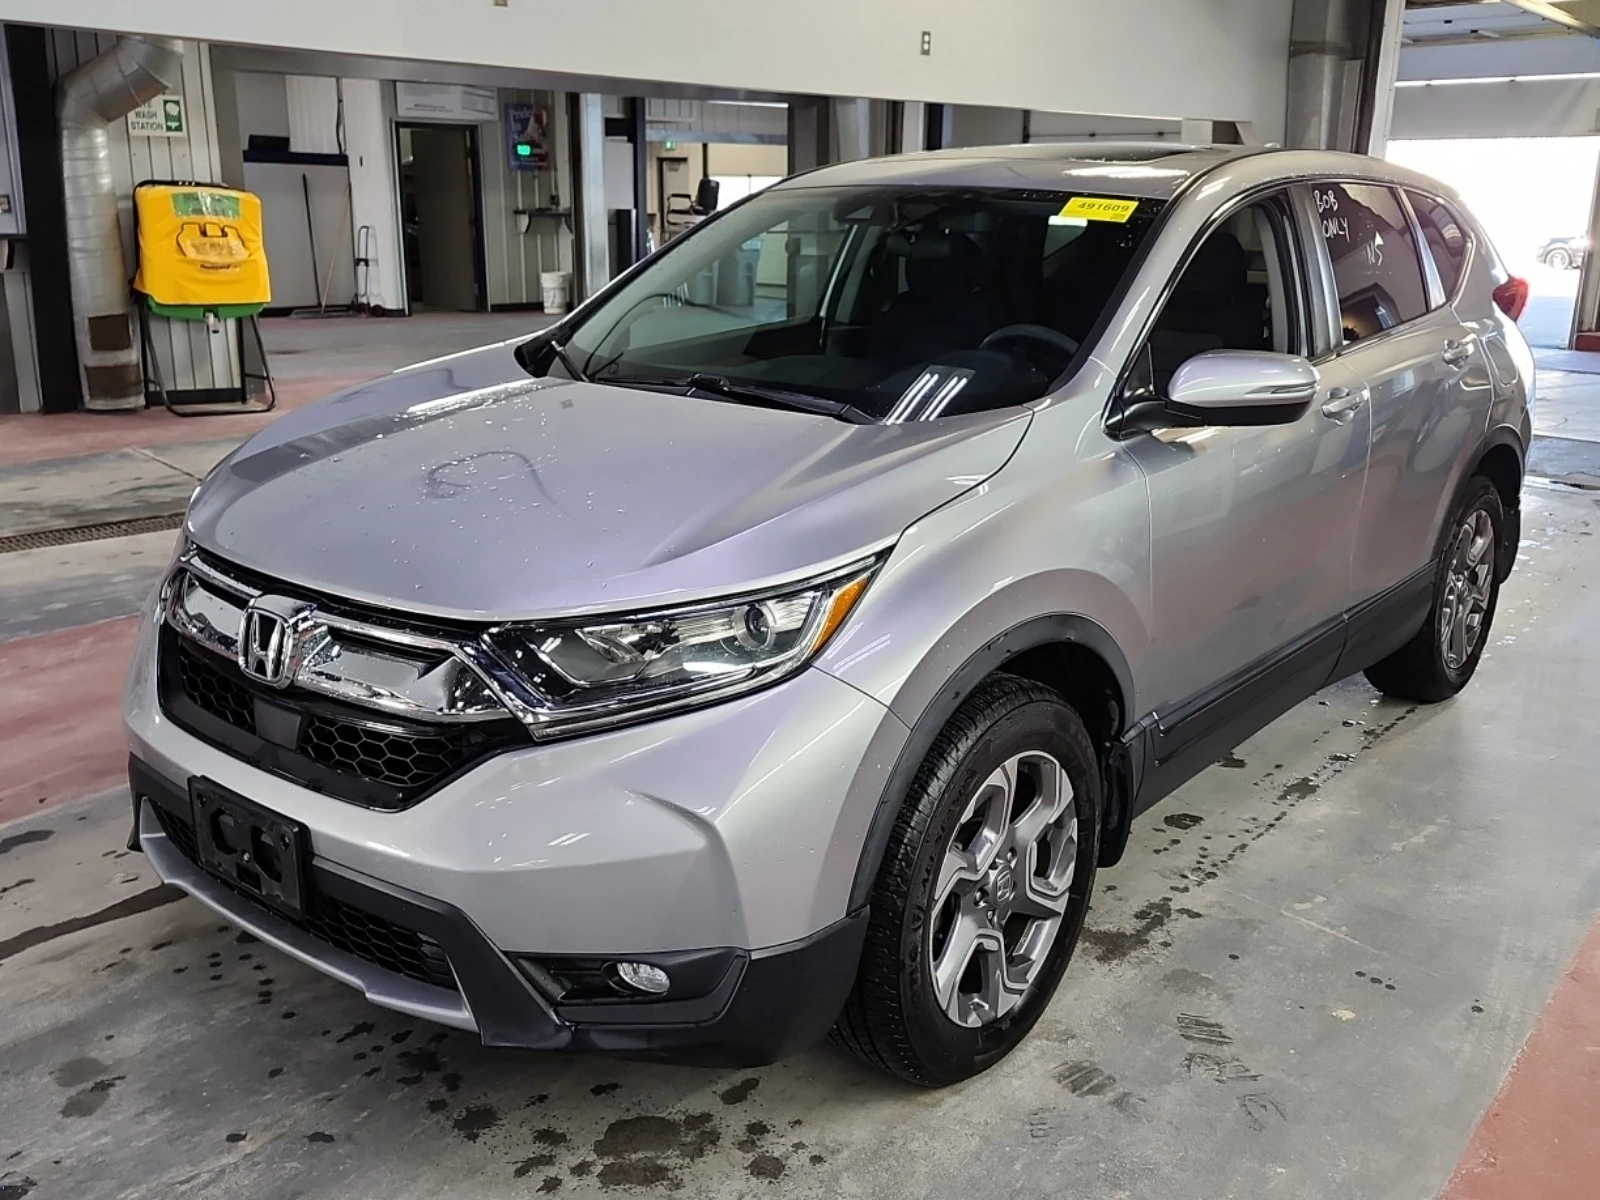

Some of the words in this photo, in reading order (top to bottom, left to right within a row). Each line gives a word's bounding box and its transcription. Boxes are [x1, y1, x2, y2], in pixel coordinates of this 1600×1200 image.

[134, 110, 158, 119] WASH
[130, 121, 164, 131] STATION
[1078, 202, 1130, 212] 491609
